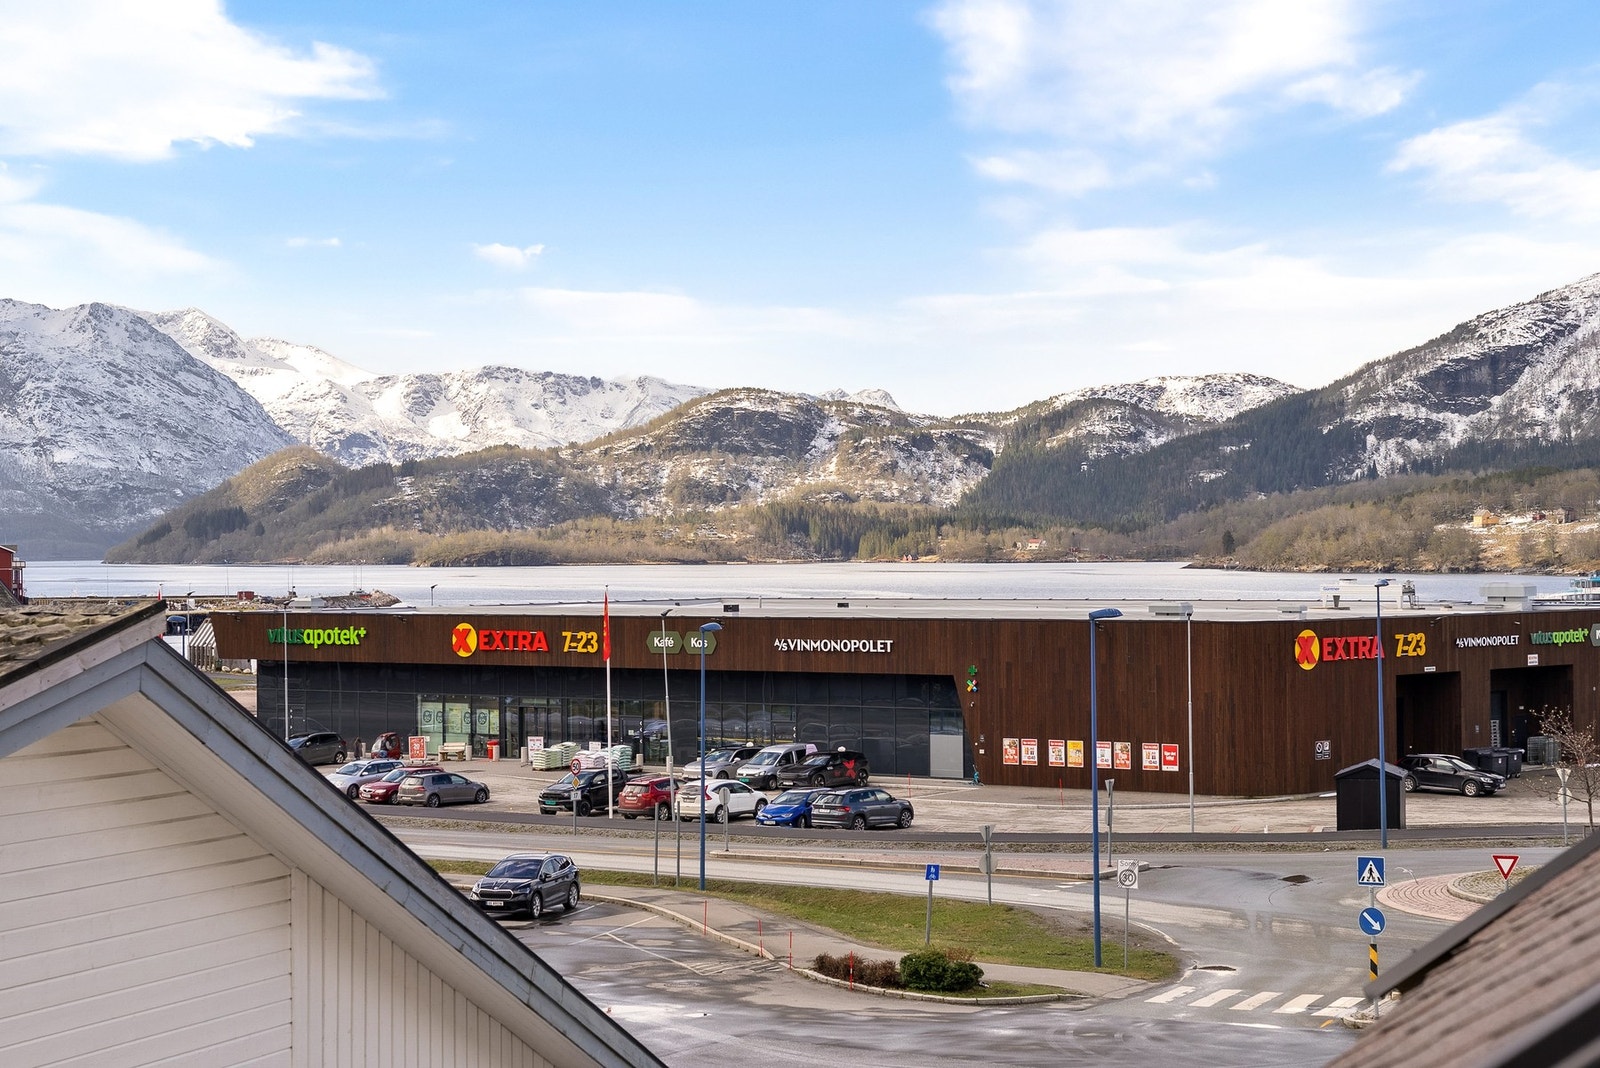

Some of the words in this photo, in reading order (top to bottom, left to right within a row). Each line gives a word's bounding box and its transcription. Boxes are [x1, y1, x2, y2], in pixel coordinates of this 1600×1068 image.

[478, 630, 549, 652] EXTRA
[561, 631, 599, 653] 7-23
[787, 639, 893, 653] VINMONOPOLET
[1322, 635, 1385, 661] EXTRA
[1394, 632, 1426, 657] 7-23
[1463, 635, 1520, 648] VINMONOPOLET
[572, 762, 579, 771] 50
[1122, 873, 1134, 883] 30
